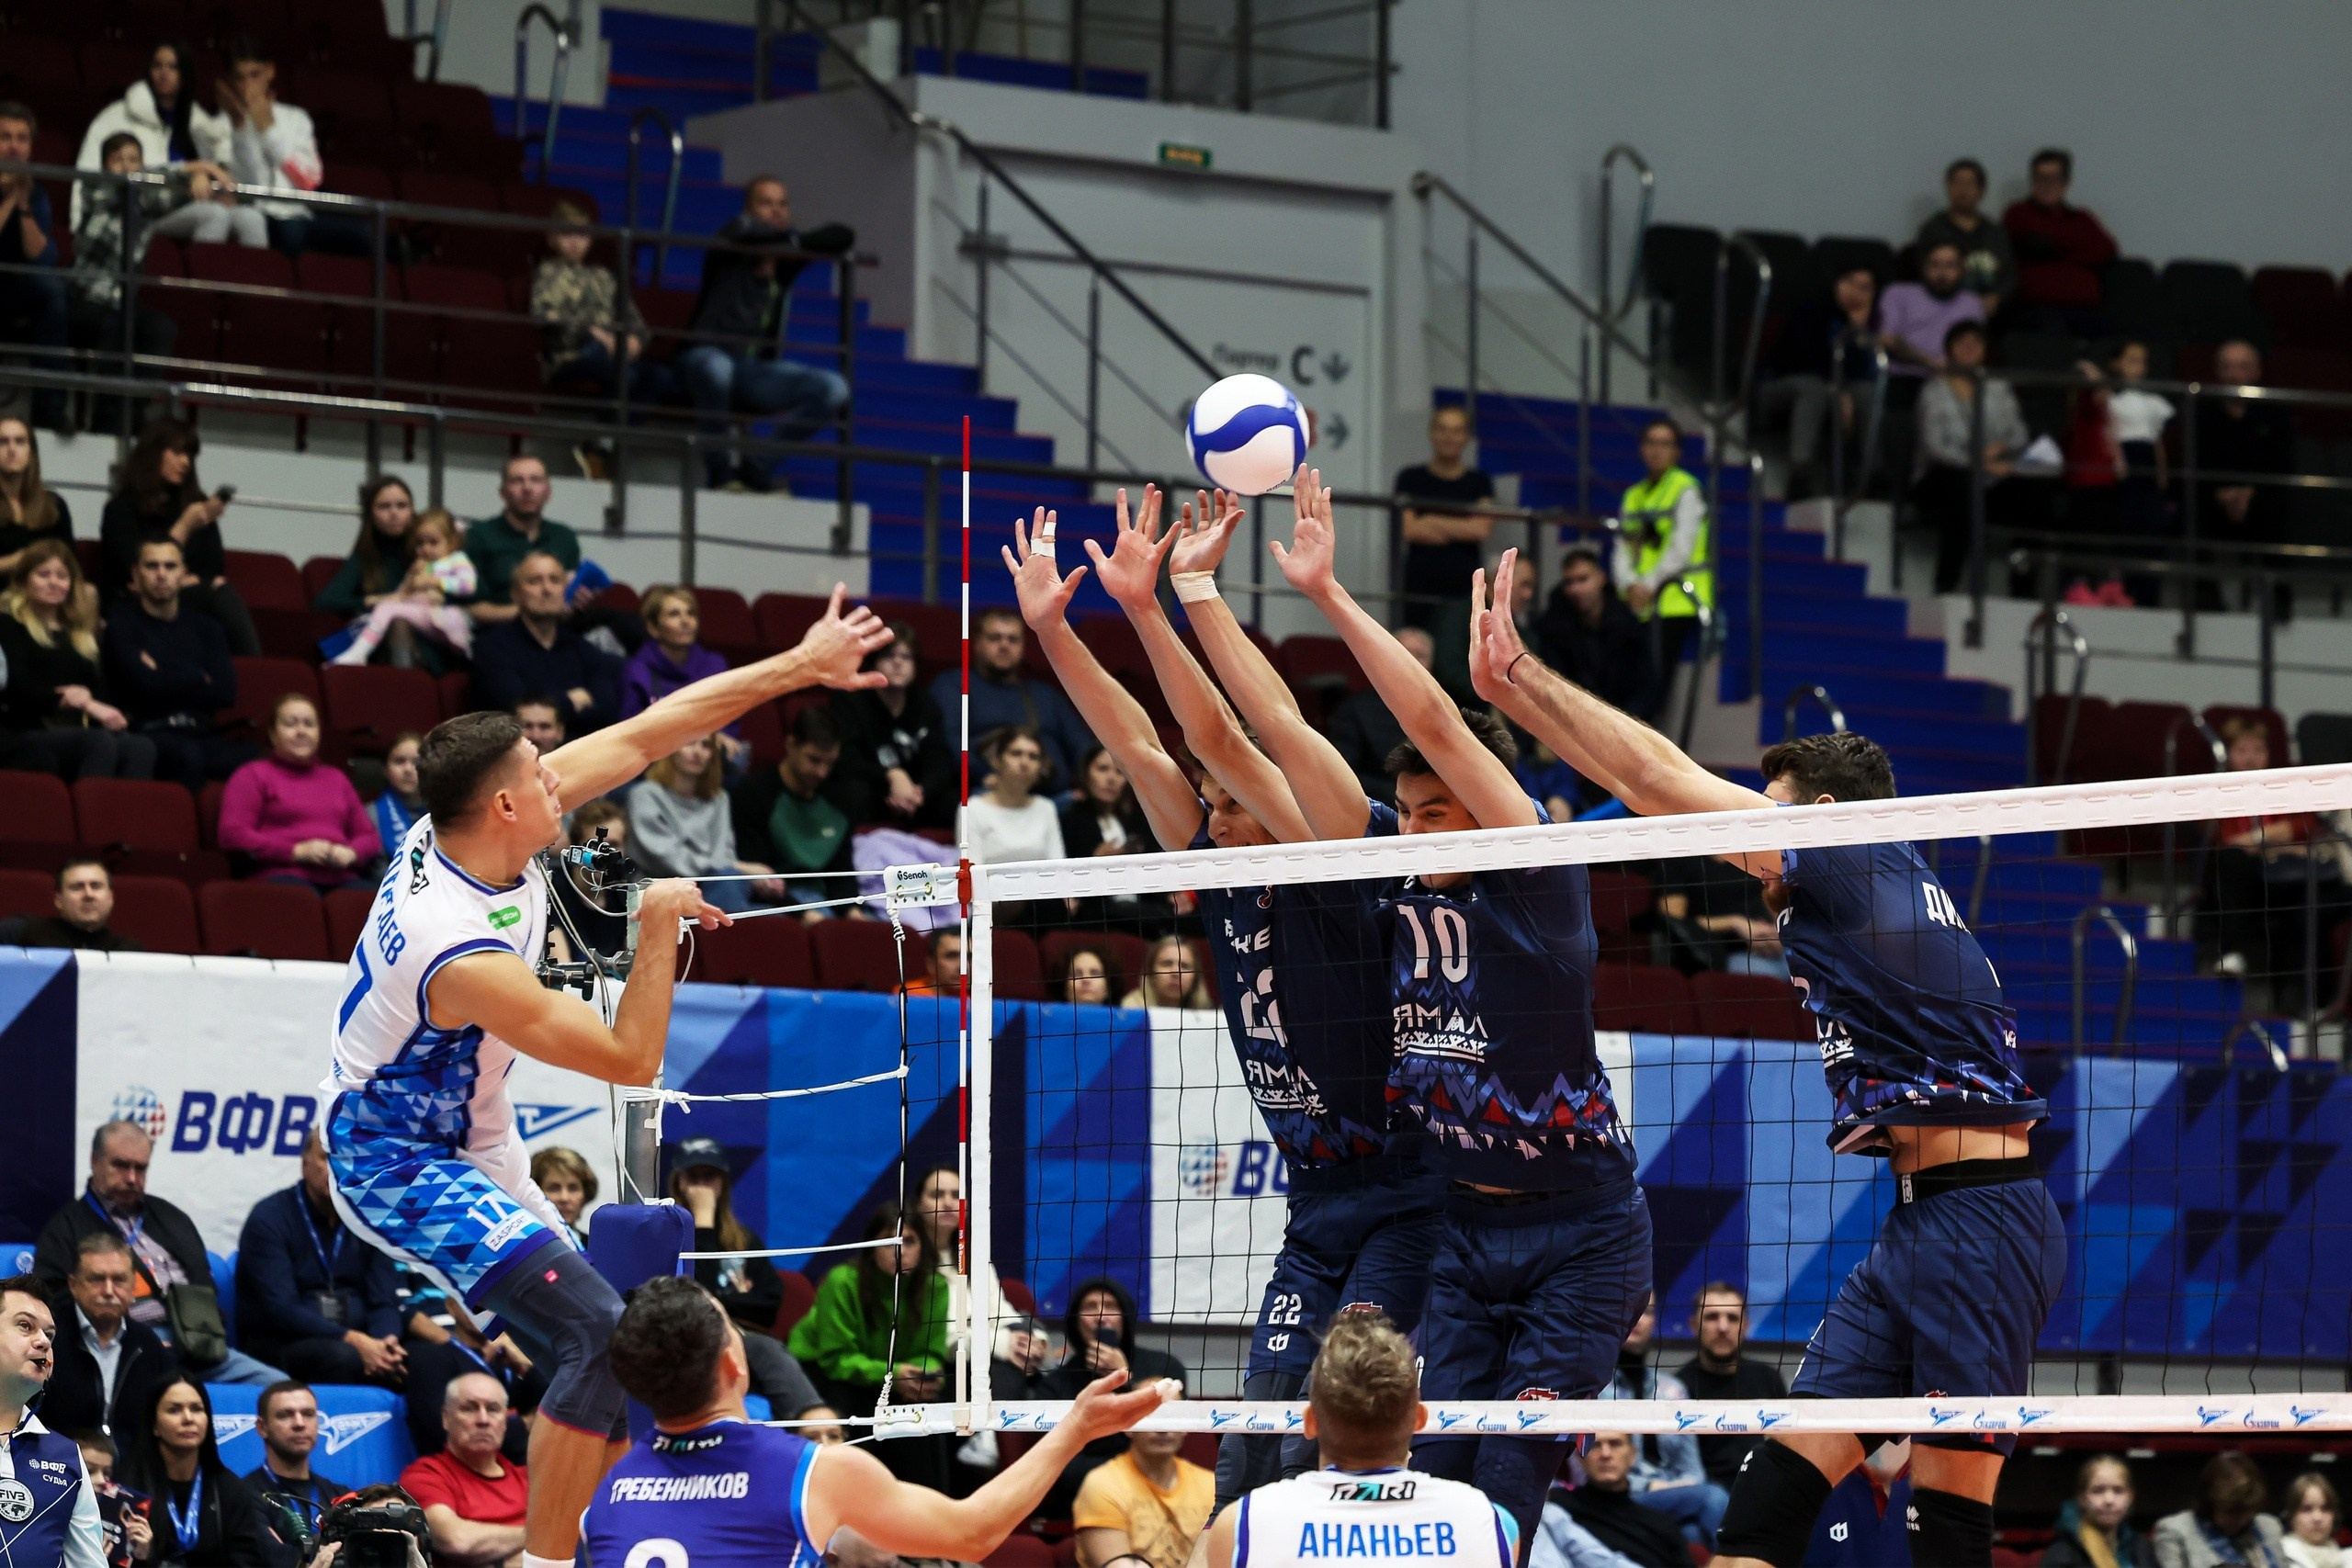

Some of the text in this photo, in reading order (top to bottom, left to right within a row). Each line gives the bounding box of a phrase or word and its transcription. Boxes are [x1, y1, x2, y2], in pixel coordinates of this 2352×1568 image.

[903, 870, 928, 881] Senoh
[1396, 905, 1468, 983] 10
[172, 1089, 319, 1156] ВФВ
[466, 1193, 508, 1232] 17
[1267, 1293, 1302, 1325] 22
[40, 1461, 66, 1474] ВФВ
[42, 1473, 68, 1487] СУДЬЯ
[609, 1472, 750, 1504] ГРЕБЕННИКОВ
[1297, 1522, 1456, 1558] АНАНЬЕВ
